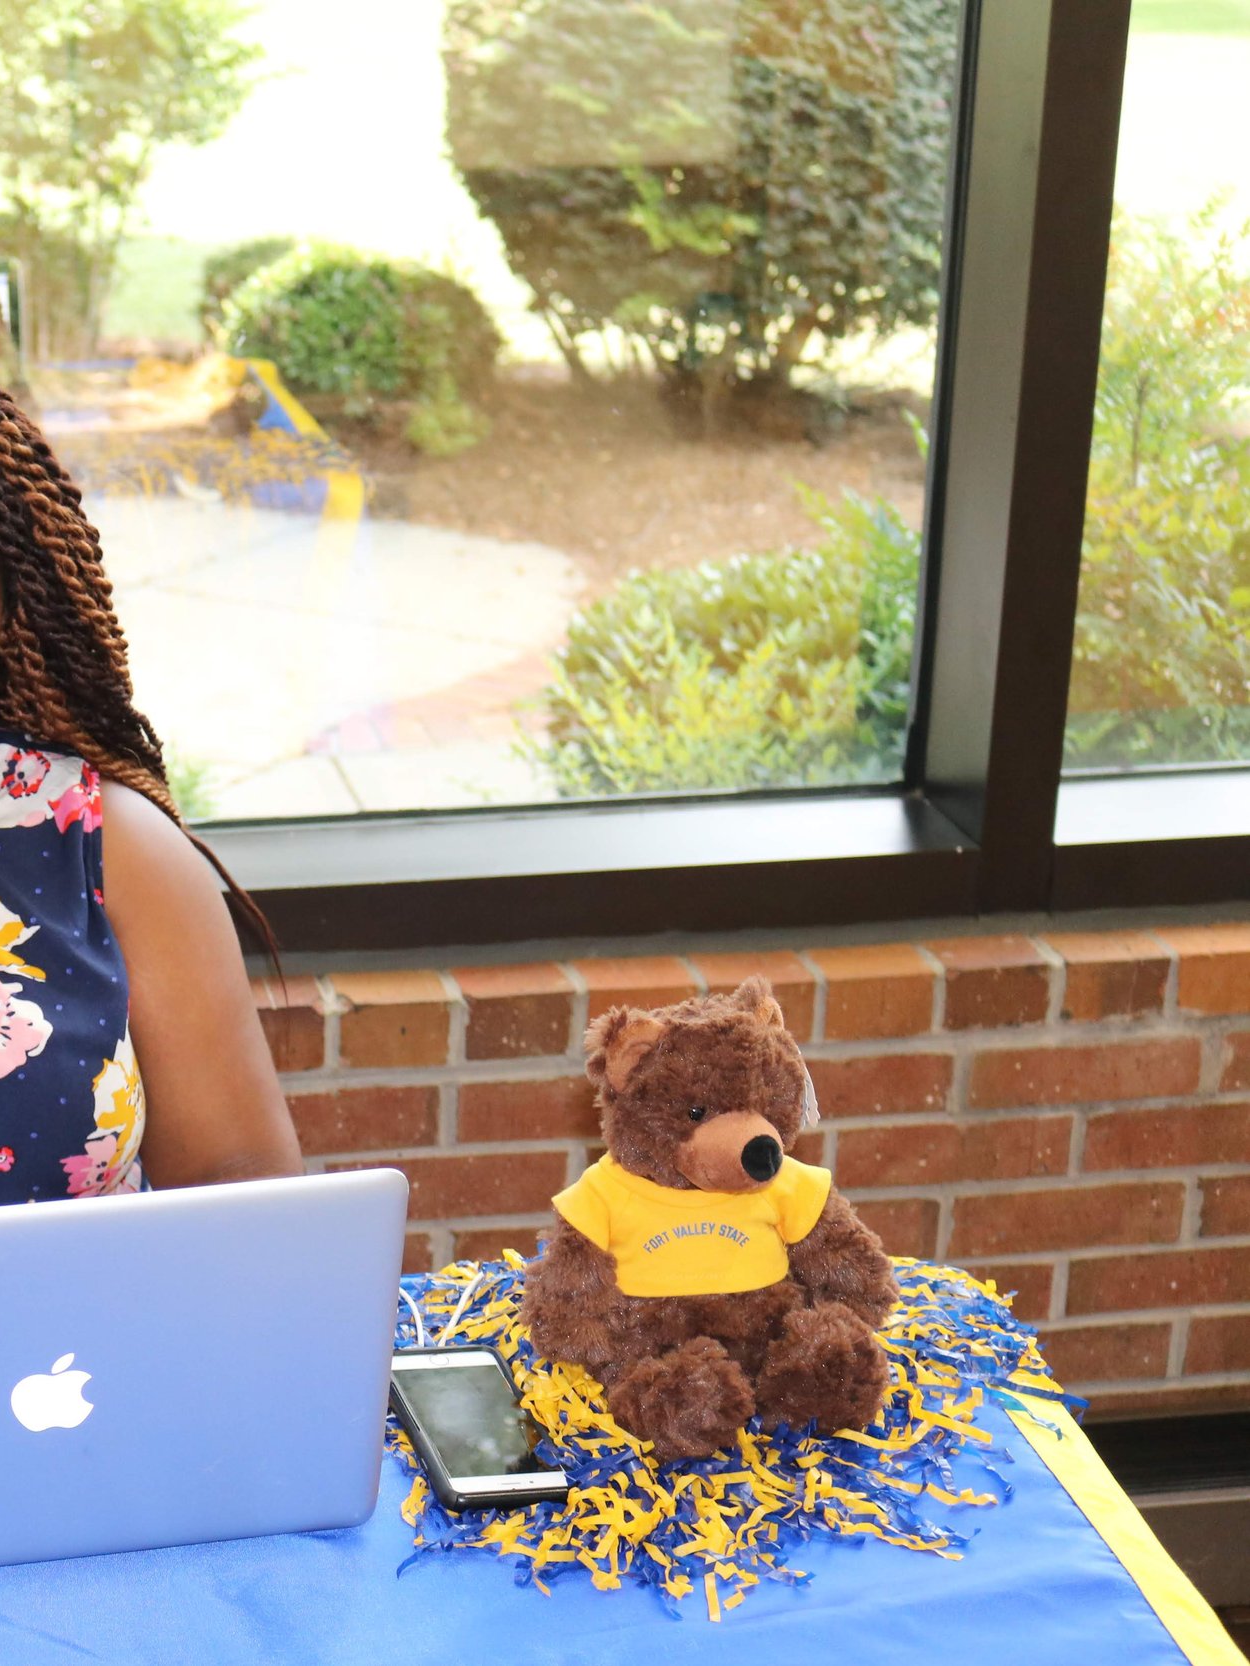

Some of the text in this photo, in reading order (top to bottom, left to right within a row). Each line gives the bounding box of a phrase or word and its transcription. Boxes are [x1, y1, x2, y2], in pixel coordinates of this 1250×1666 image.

[643, 1222, 750, 1254] FORT VALLEY STATE
